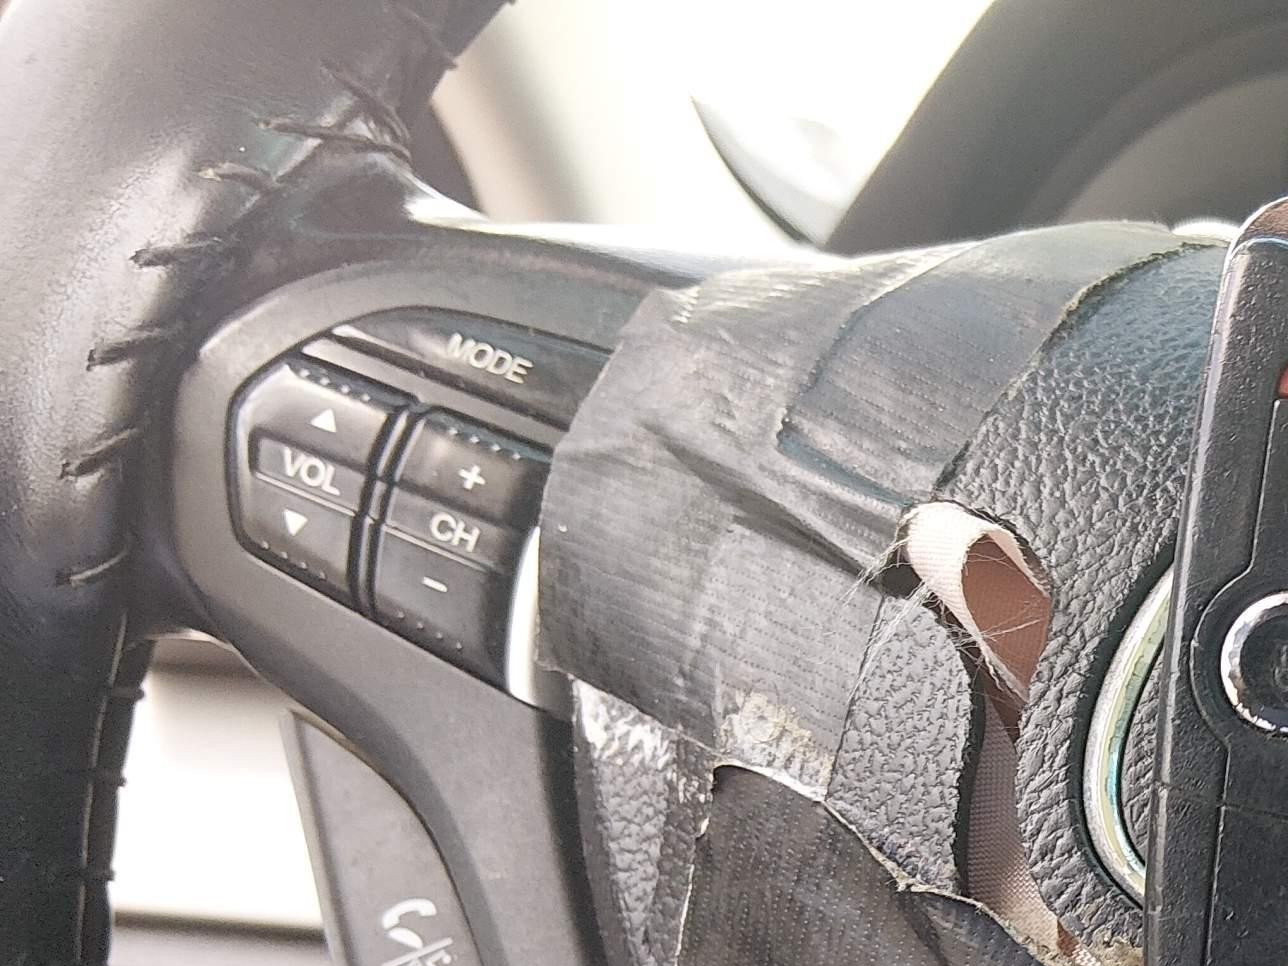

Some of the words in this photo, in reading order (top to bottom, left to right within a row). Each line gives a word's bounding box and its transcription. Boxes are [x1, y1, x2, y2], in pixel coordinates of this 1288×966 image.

[447, 332, 535, 385] MODE
[281, 447, 341, 496] VOL
[428, 511, 481, 553] CH
